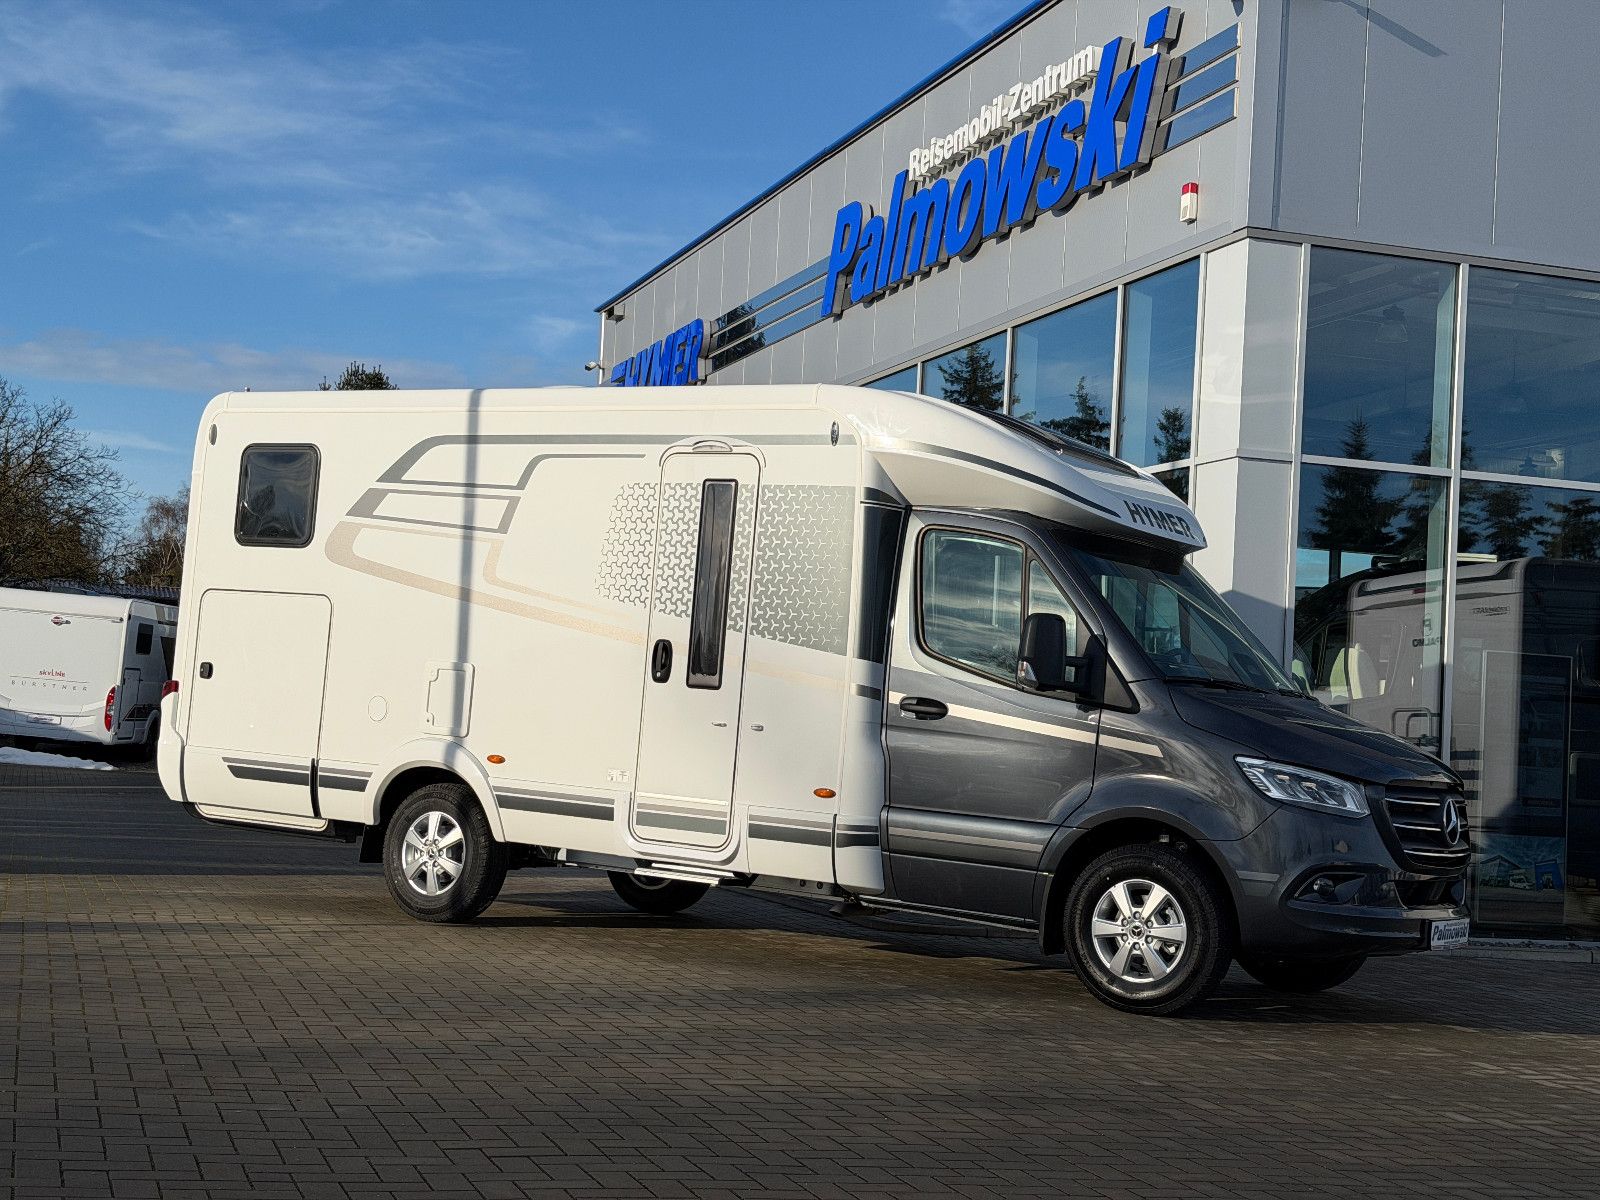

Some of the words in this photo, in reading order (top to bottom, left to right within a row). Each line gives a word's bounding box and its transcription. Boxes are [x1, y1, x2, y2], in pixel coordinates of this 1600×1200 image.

[821, 6, 1177, 318] Palmowski
[908, 45, 1100, 181] Reisemobil-Zentrum
[624, 318, 704, 387] HYMER
[1123, 499, 1195, 540] HYMER
